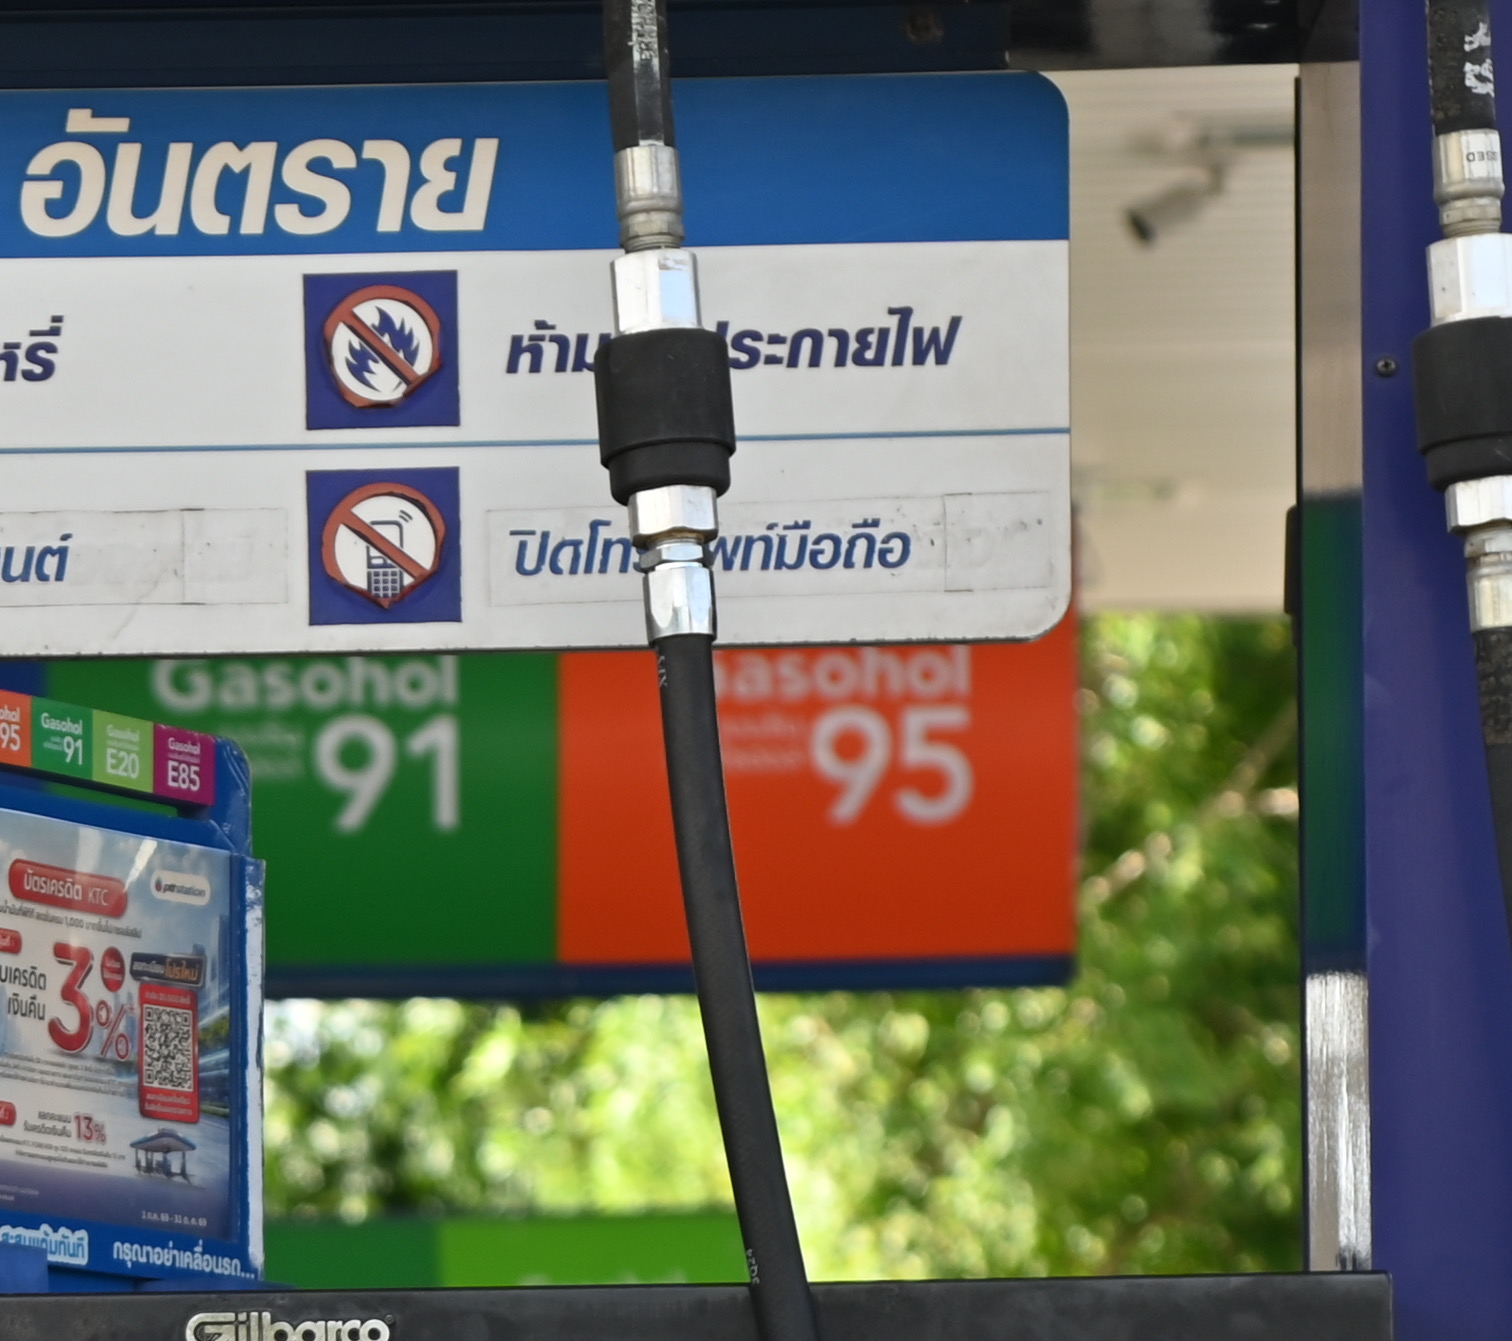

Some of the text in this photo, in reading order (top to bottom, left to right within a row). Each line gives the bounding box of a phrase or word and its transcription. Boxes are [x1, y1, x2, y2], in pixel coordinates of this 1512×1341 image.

[19, 107, 500, 238] อันตราย
[714, 648, 973, 700] asohol
[0, 725, 22, 751] 95
[41, 712, 83, 736] Gasohol
[63, 736, 83, 766] 91
[168, 737, 201, 755] Gasohol
[106, 748, 140, 780] E20
[167, 761, 201, 792] E85
[312, 714, 461, 834] 91
[810, 707, 975, 828] 95
[23, 870, 109, 906] บัตรเครดิต KTC
[7, 991, 46, 1021] เงินคืน
